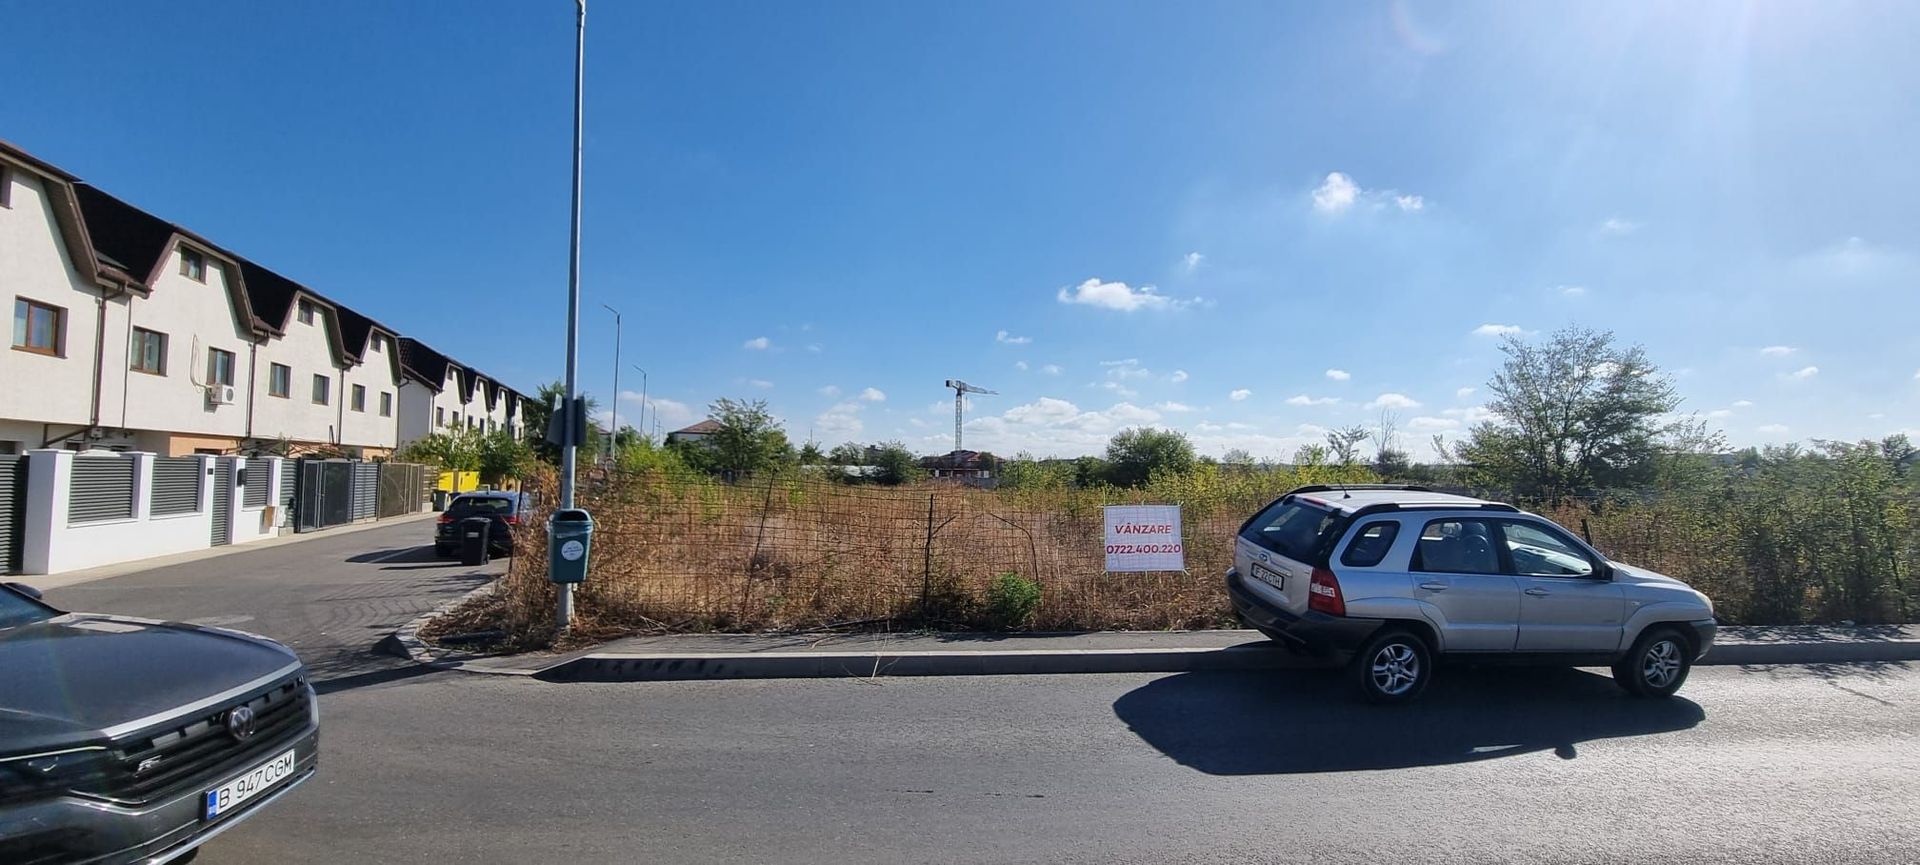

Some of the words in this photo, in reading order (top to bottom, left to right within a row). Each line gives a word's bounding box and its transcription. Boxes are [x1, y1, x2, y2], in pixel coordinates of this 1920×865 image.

[1114, 522, 1172, 534] VÂNZARE
[1106, 544, 1181, 554] 0722.400.220
[219, 788, 230, 808] B
